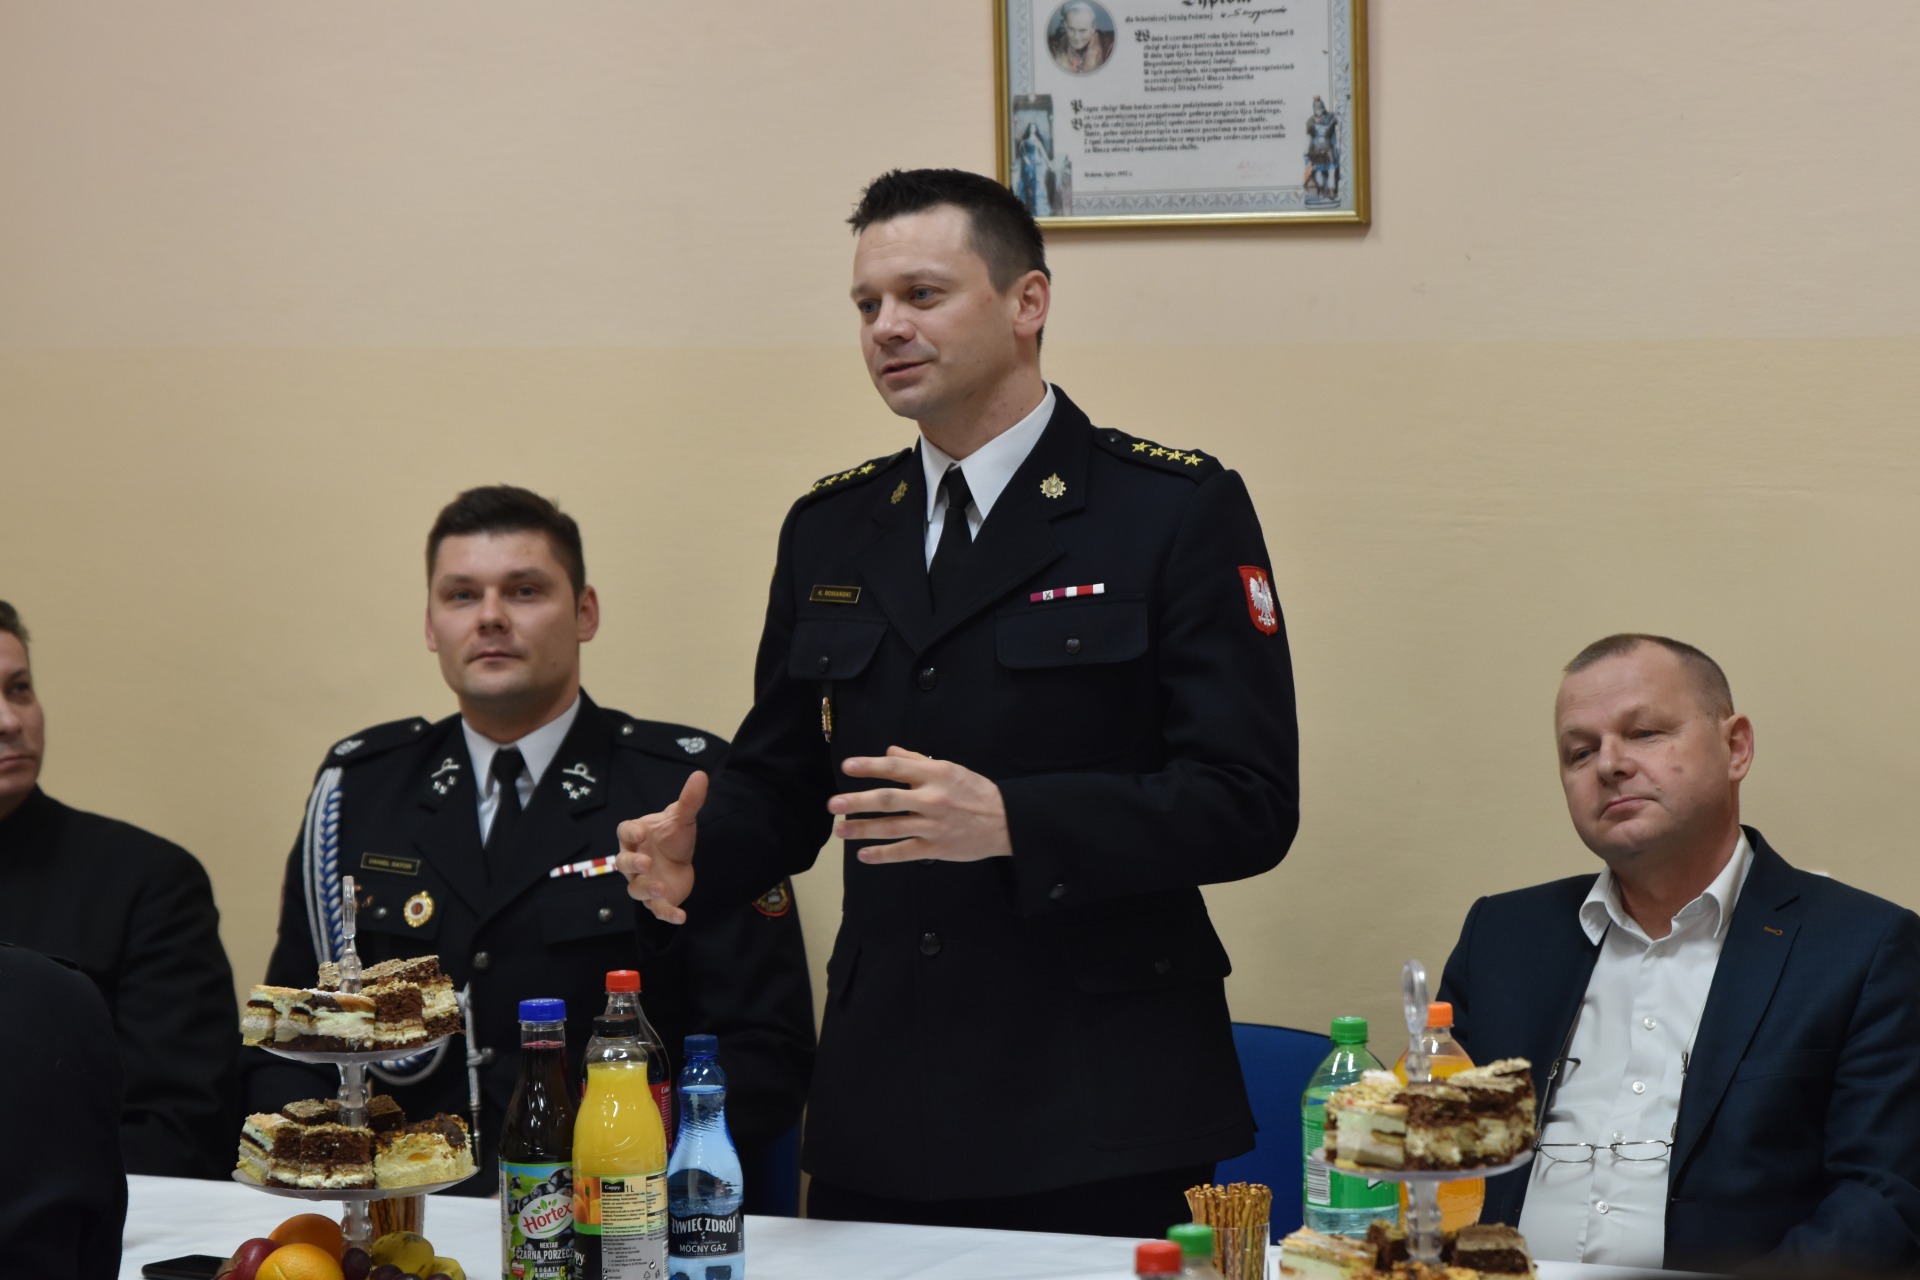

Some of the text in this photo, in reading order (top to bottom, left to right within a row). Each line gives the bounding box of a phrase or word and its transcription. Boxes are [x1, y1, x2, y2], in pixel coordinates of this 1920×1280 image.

[523, 1202, 573, 1234] Hortex
[705, 1216, 736, 1233] ZDRÓJ
[516, 1248, 574, 1260] CZARNA PORZECZ
[680, 1243, 727, 1253] MOCNY GAZ
